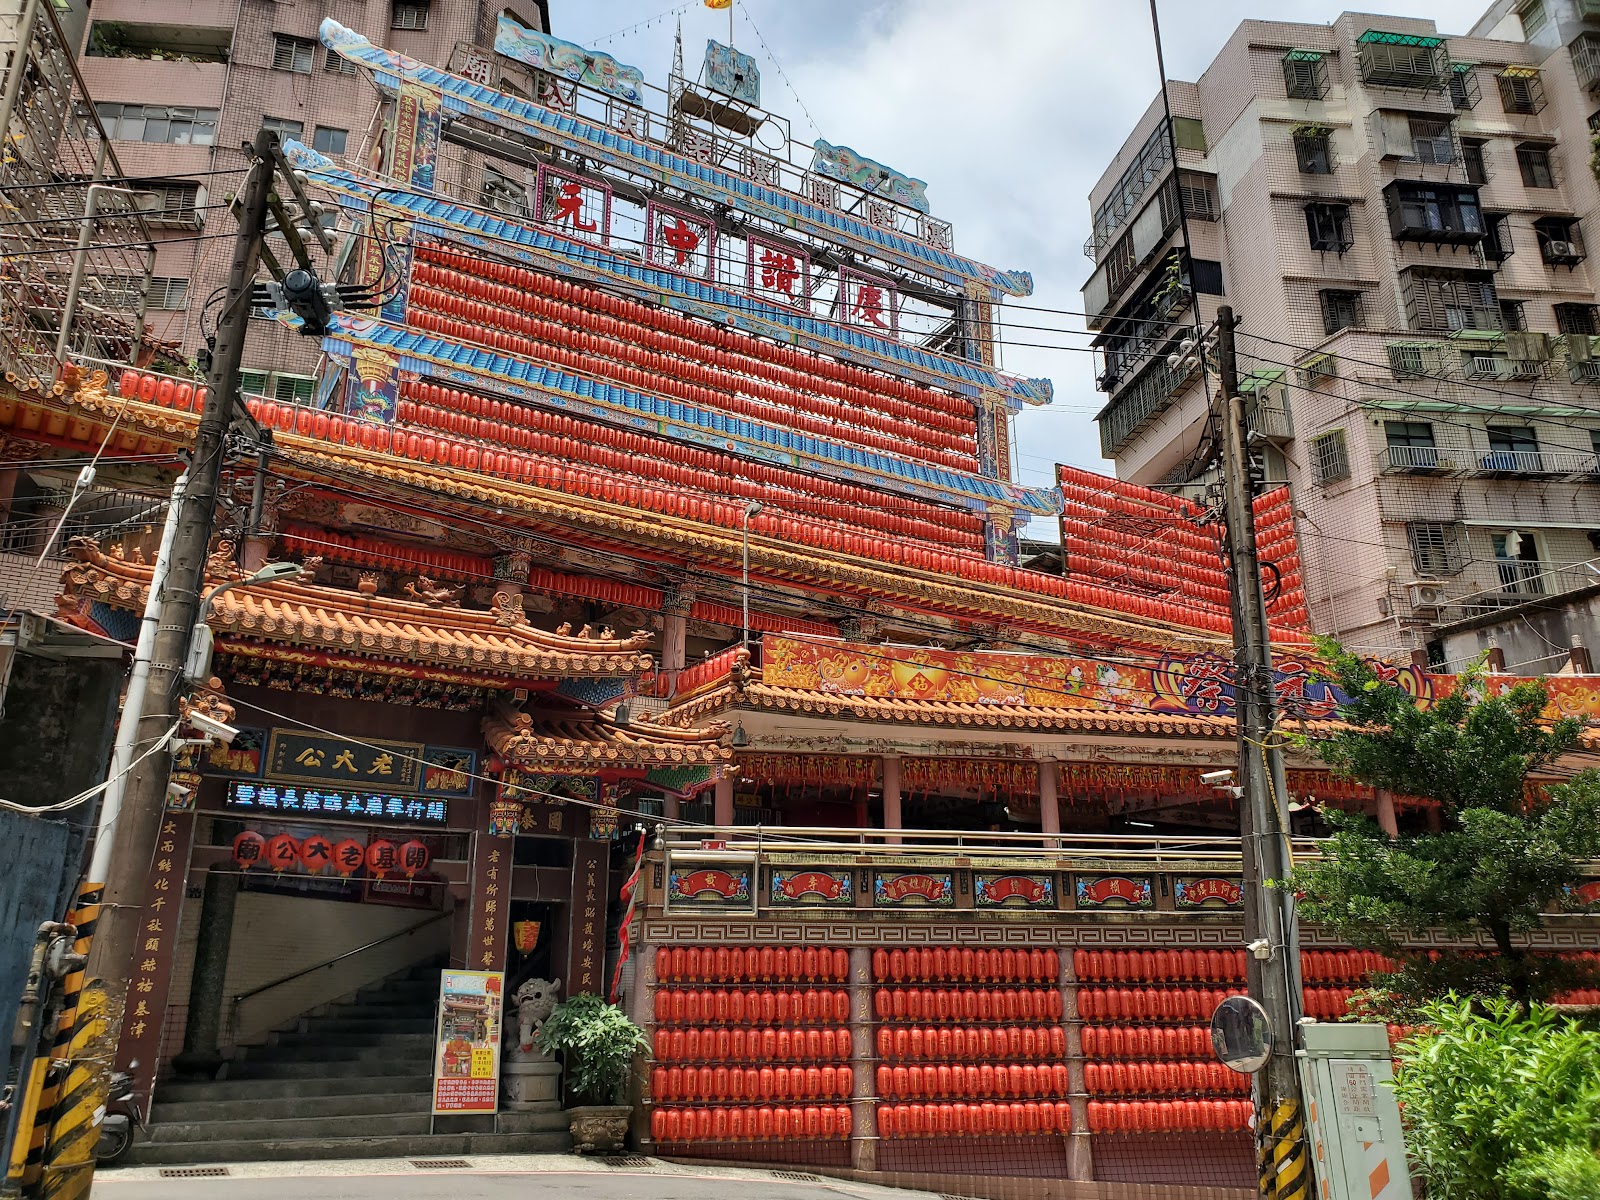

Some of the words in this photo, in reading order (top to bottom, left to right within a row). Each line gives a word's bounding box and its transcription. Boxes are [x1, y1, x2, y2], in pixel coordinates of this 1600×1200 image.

[553, 183, 889, 331] 慶讚中元
[295, 747, 394, 775] 老大公
[236, 837, 425, 869] 開基老大公廟
[480, 849, 501, 972] 老有所歸萬世馨
